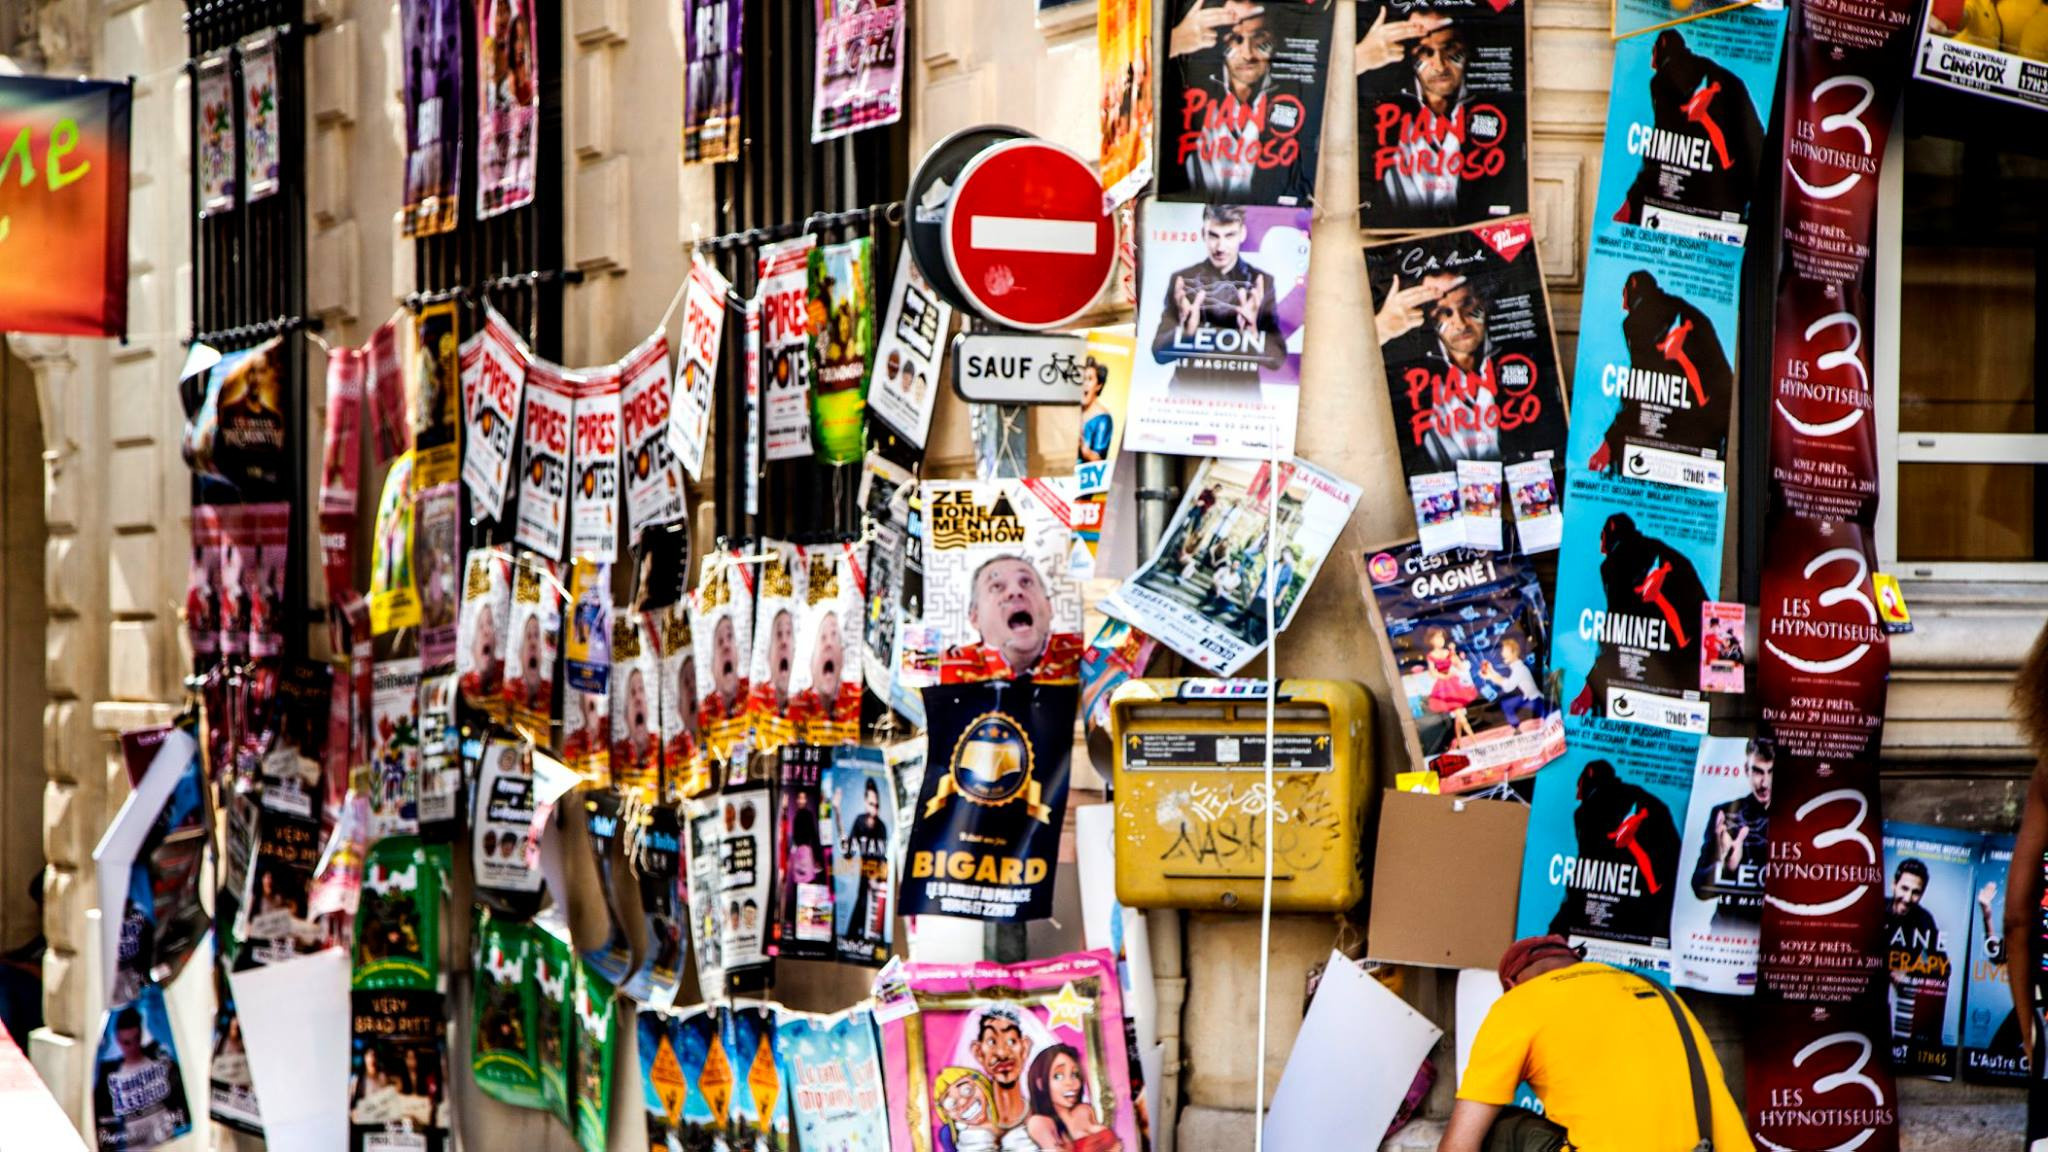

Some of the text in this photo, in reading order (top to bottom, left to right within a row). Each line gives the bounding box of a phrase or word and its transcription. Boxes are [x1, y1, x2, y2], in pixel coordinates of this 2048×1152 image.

[1797, 119, 1815, 141] LES
[1811, 75, 1875, 154] 3
[1176, 130, 1299, 167] FURIOSO
[1627, 121, 1713, 172] CRIMINEL
[1790, 135, 1877, 175] HYPNOTISEURS
[1373, 145, 1505, 182] FURIOSO
[1173, 322, 1266, 353] LÉON
[1805, 312, 1868, 391] 3
[968, 356, 1033, 379] SAUF
[1193, 358, 1258, 372] MAGICIEN
[1788, 358, 1809, 380] LES
[1601, 363, 1691, 410] CRIMINEL
[1779, 377, 1874, 411] HYPNOTISEURS
[525, 400, 567, 456] PIRES
[622, 376, 670, 449] PIRES
[1408, 393, 1543, 447] FURIOSO
[576, 413, 615, 456] PIRES
[1295, 469, 1353, 505] LA FAMILLE
[933, 516, 1025, 531] MENTAL
[968, 527, 1025, 543] SHOW
[1404, 552, 1450, 576] C'EST
[1803, 547, 1878, 625] 3
[1783, 597, 1811, 618] LES
[1579, 607, 1671, 652] CRIMINEL
[1771, 618, 1886, 643] HYPNOTISEURS
[1763, 708, 1778, 721] DU
[1789, 712, 1804, 722] AU
[1807, 712, 1820, 724] 29
[1822, 712, 1856, 725] JUILLET
[1791, 697, 1824, 709] SOYEZ
[1795, 788, 1875, 864] 3
[912, 849, 1048, 885] BIGARD
[1770, 841, 1802, 861] LES
[1549, 853, 1642, 898] CRIMINEL
[1779, 954, 1796, 965] AU
[1798, 954, 1812, 966] 29
[1815, 955, 1853, 968] JUILLET
[1780, 940, 1816, 952] SOYEZ
[372, 998, 408, 1014] VERY
[355, 1016, 395, 1034] BRAD
[1793, 1031, 1884, 1106] 3
[1771, 1088, 1803, 1108] LES
[1760, 1108, 1893, 1127] HYPNOTISEURS
